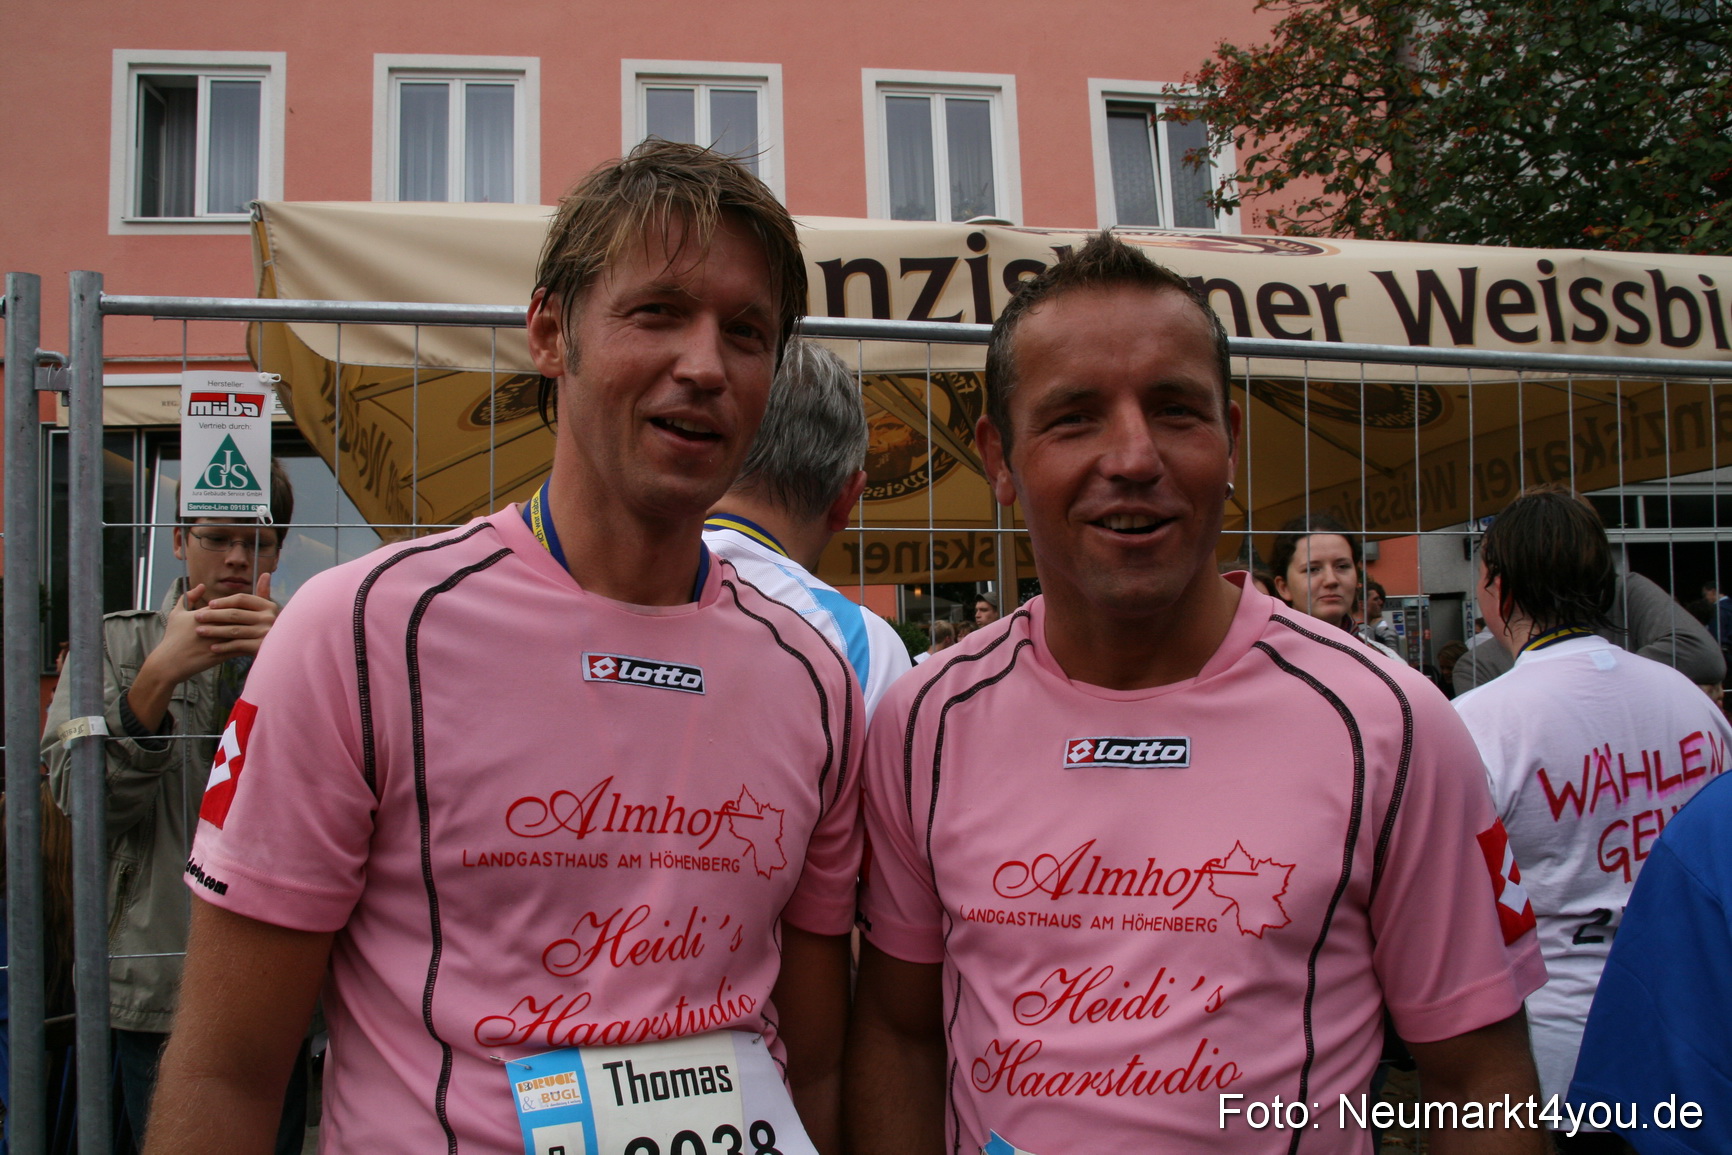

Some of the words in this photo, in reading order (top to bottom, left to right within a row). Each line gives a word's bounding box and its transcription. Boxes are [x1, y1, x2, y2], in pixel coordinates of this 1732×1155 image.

[1370, 259, 1732, 350] Weissbi
[190, 393, 260, 417] müba
[207, 380, 245, 388] Hersteller:
[198, 422, 227, 430] Vertrieb
[228, 422, 252, 431] durch:
[188, 503, 229, 511] Service-Line
[618, 660, 702, 689] lotto
[1094, 740, 1186, 762] lotto
[1537, 730, 1726, 822] WÄHLEN
[505, 775, 738, 850] Almhof
[993, 839, 1221, 910] Almhof
[474, 976, 757, 1048] Haarstudio
[602, 1059, 733, 1106] Thomas
[971, 1038, 1243, 1097] Haarstudio
